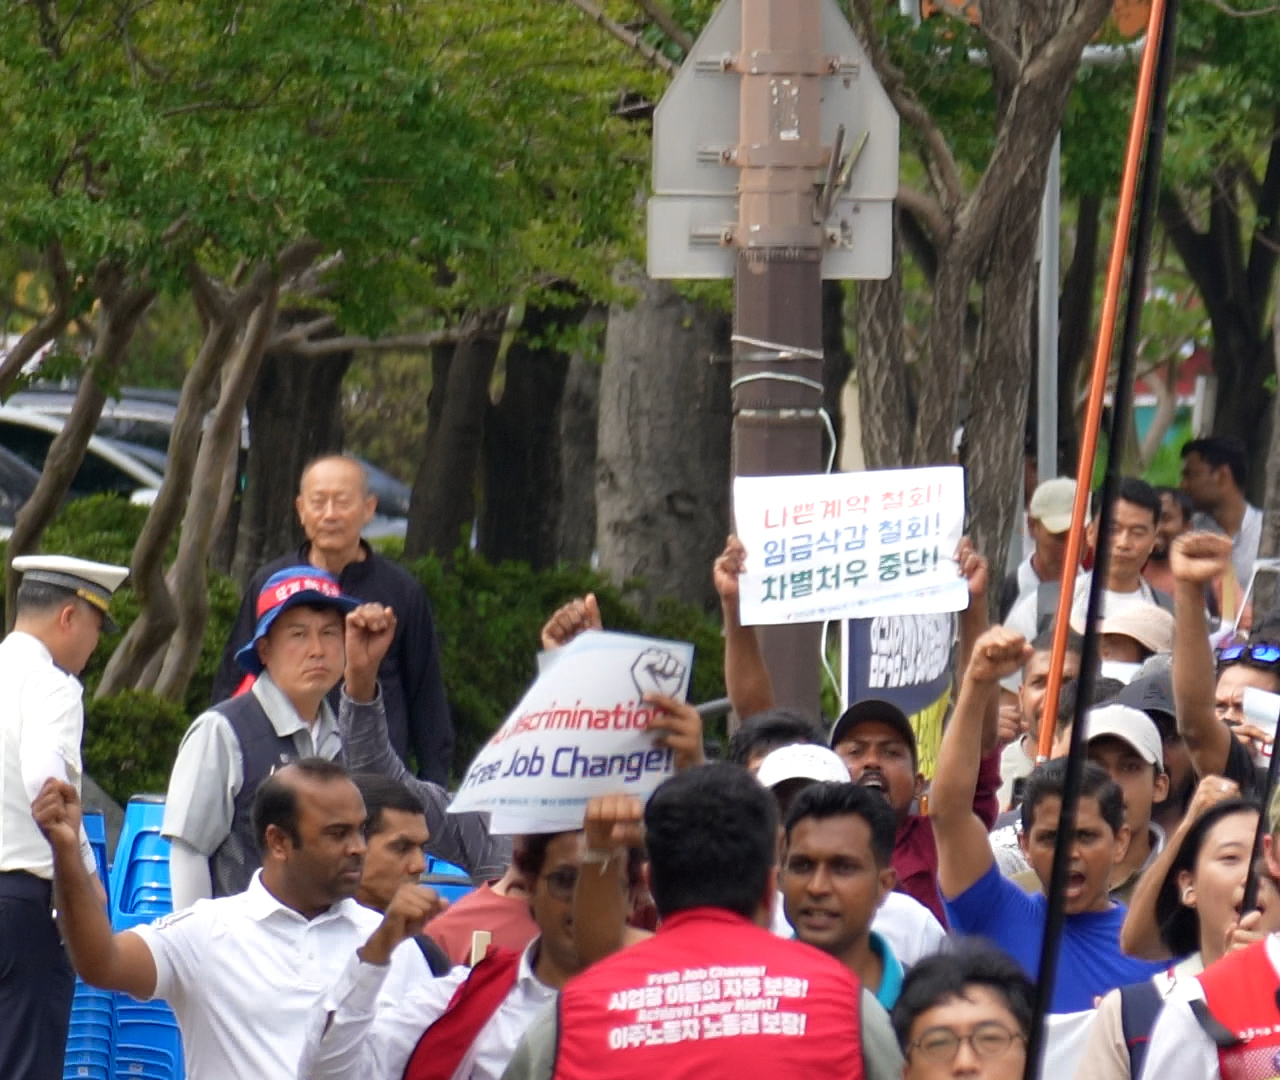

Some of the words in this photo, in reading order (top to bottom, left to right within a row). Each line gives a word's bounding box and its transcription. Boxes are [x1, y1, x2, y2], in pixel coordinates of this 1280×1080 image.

[764, 494, 870, 530] 나쁜계약
[881, 483, 942, 511] 철회!
[763, 524, 870, 568] 임금삭감
[878, 512, 941, 545] 철회!
[761, 559, 869, 604] 차별처우
[877, 545, 940, 581] 중단!
[502, 745, 546, 778] Job
[551, 746, 673, 784] Change!
[608, 985, 664, 1012] 사업장
[722, 977, 762, 999] 자유
[763, 975, 809, 999] 보장!
[608, 1018, 700, 1050] 이주노동자
[702, 1012, 761, 1040] 노동권
[761, 1011, 807, 1037] 보장!
